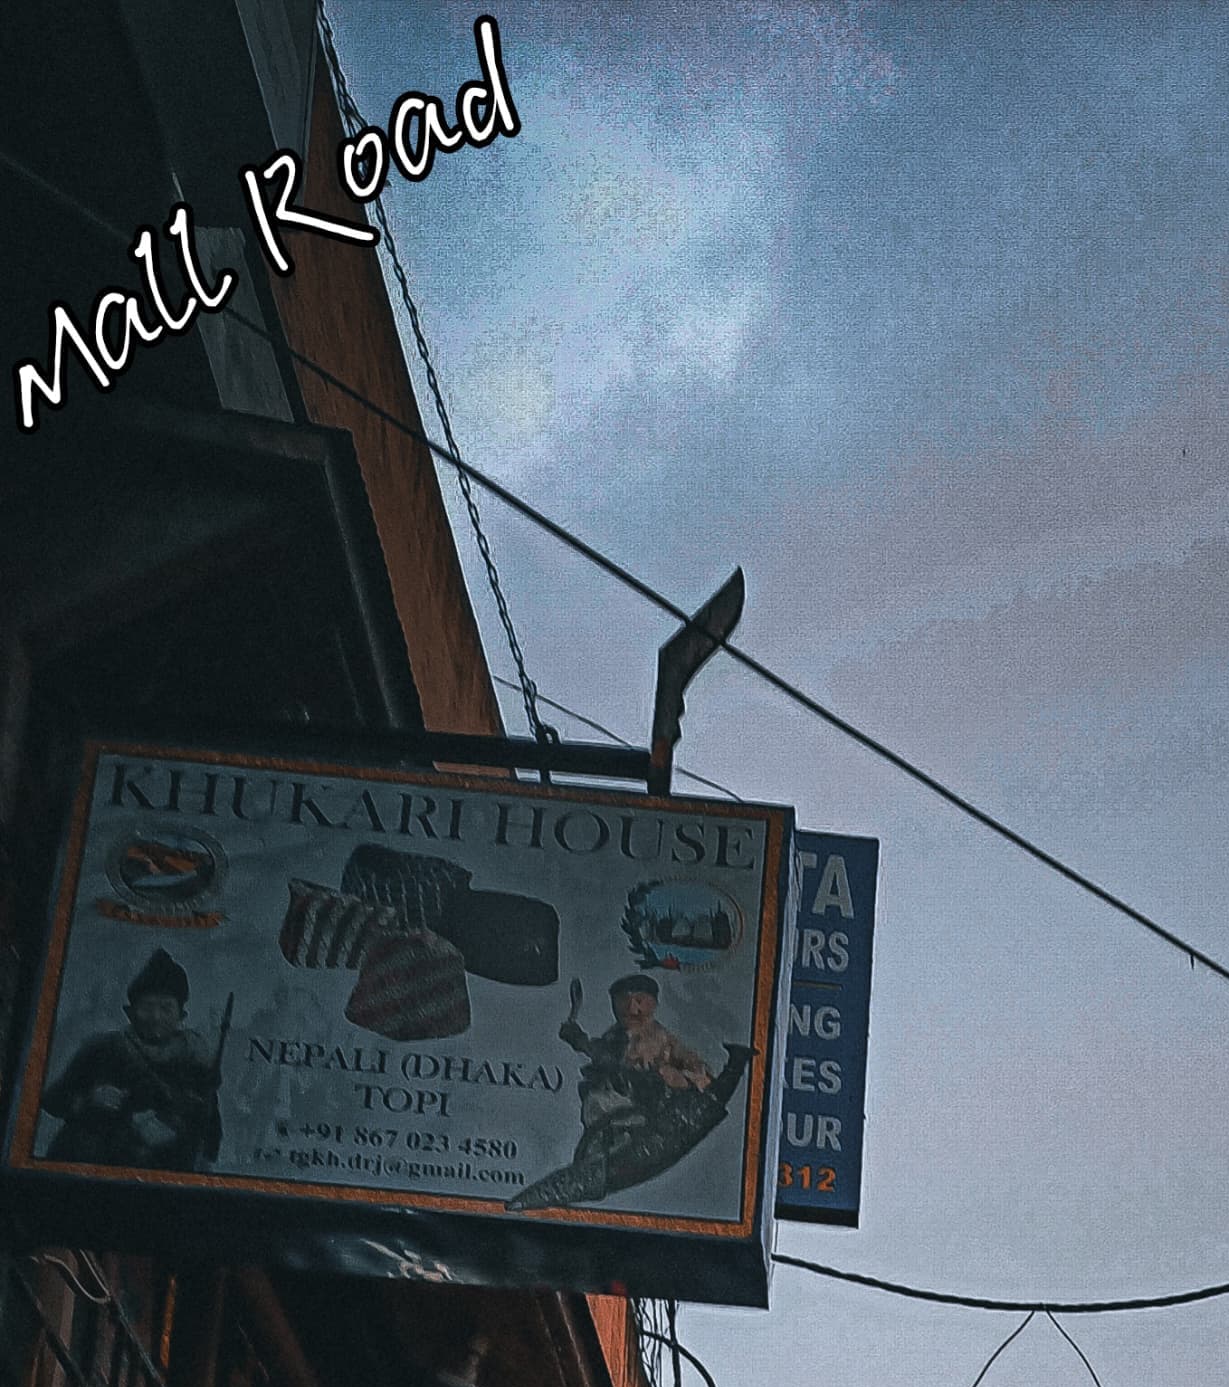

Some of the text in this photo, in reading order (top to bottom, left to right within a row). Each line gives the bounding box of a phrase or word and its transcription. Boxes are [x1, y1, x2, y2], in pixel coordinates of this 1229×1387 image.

[111, 762, 757, 871] KHUKARI HOUSE
[249, 1038, 563, 1093] NEPALI (DHAKA)
[354, 1084, 450, 1117] TOPI
[300, 1122, 518, 1160] +91 867 023 4580
